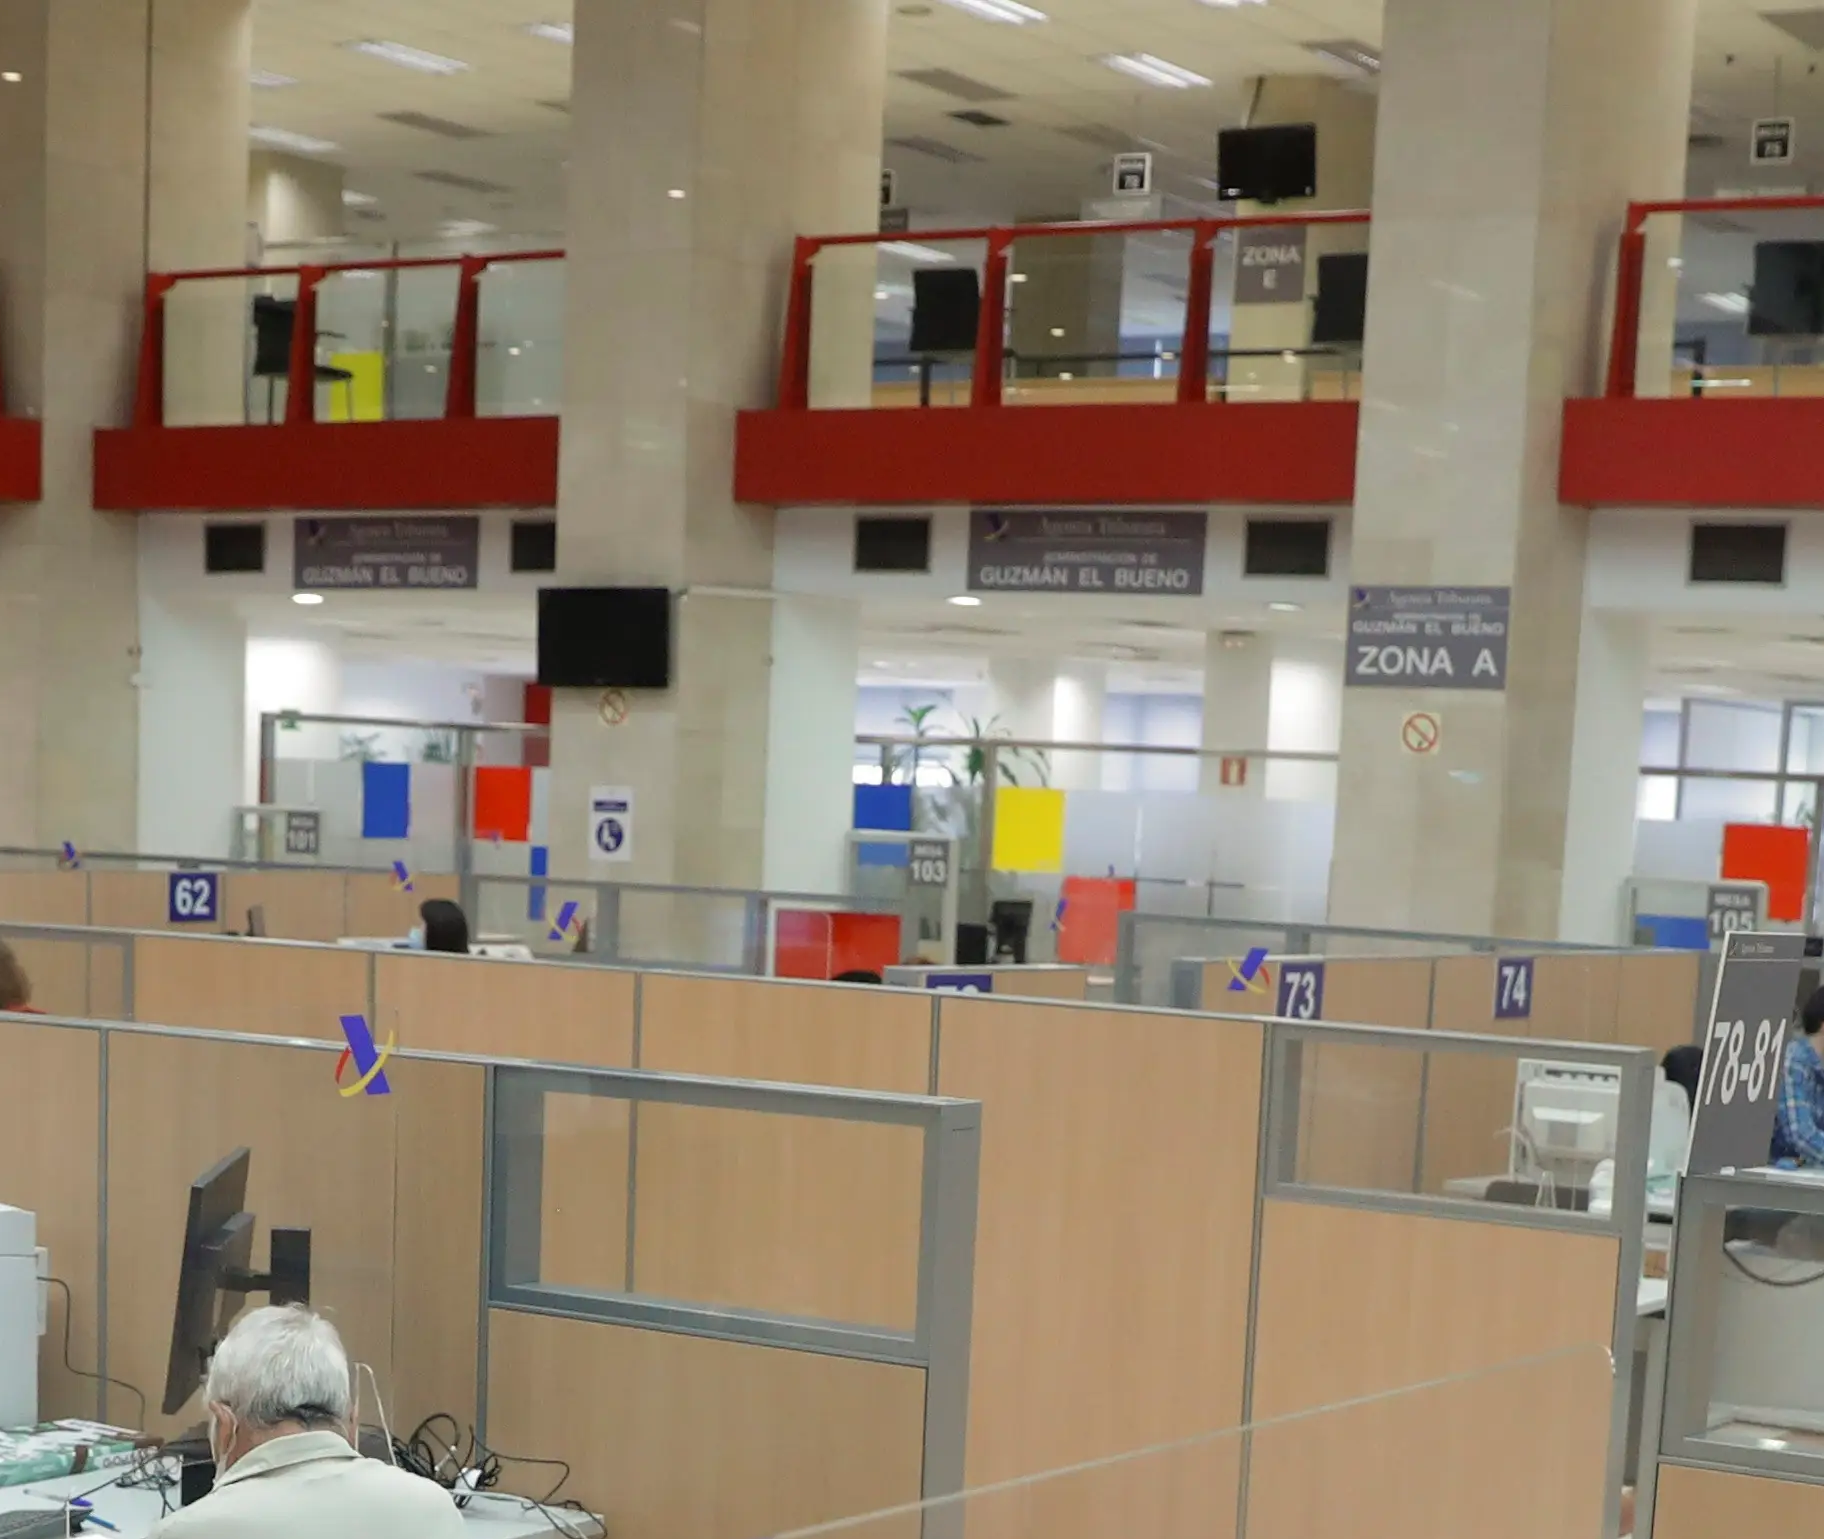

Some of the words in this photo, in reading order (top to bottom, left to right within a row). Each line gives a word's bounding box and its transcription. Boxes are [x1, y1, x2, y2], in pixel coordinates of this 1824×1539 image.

[1242, 245, 1302, 266] ZONA
[979, 562, 1069, 587] GUZMÁN
[1079, 566, 1104, 587] EL
[1113, 567, 1191, 589] BUENO
[1355, 644, 1455, 678] ZONA
[1471, 647, 1499, 678] A
[910, 859, 947, 883] 103
[175, 879, 211, 915] 62
[1708, 909, 1754, 934] 105
[1285, 971, 1317, 1019] 73
[1501, 965, 1528, 1010] 74
[1704, 1017, 1787, 1106] 78-81
